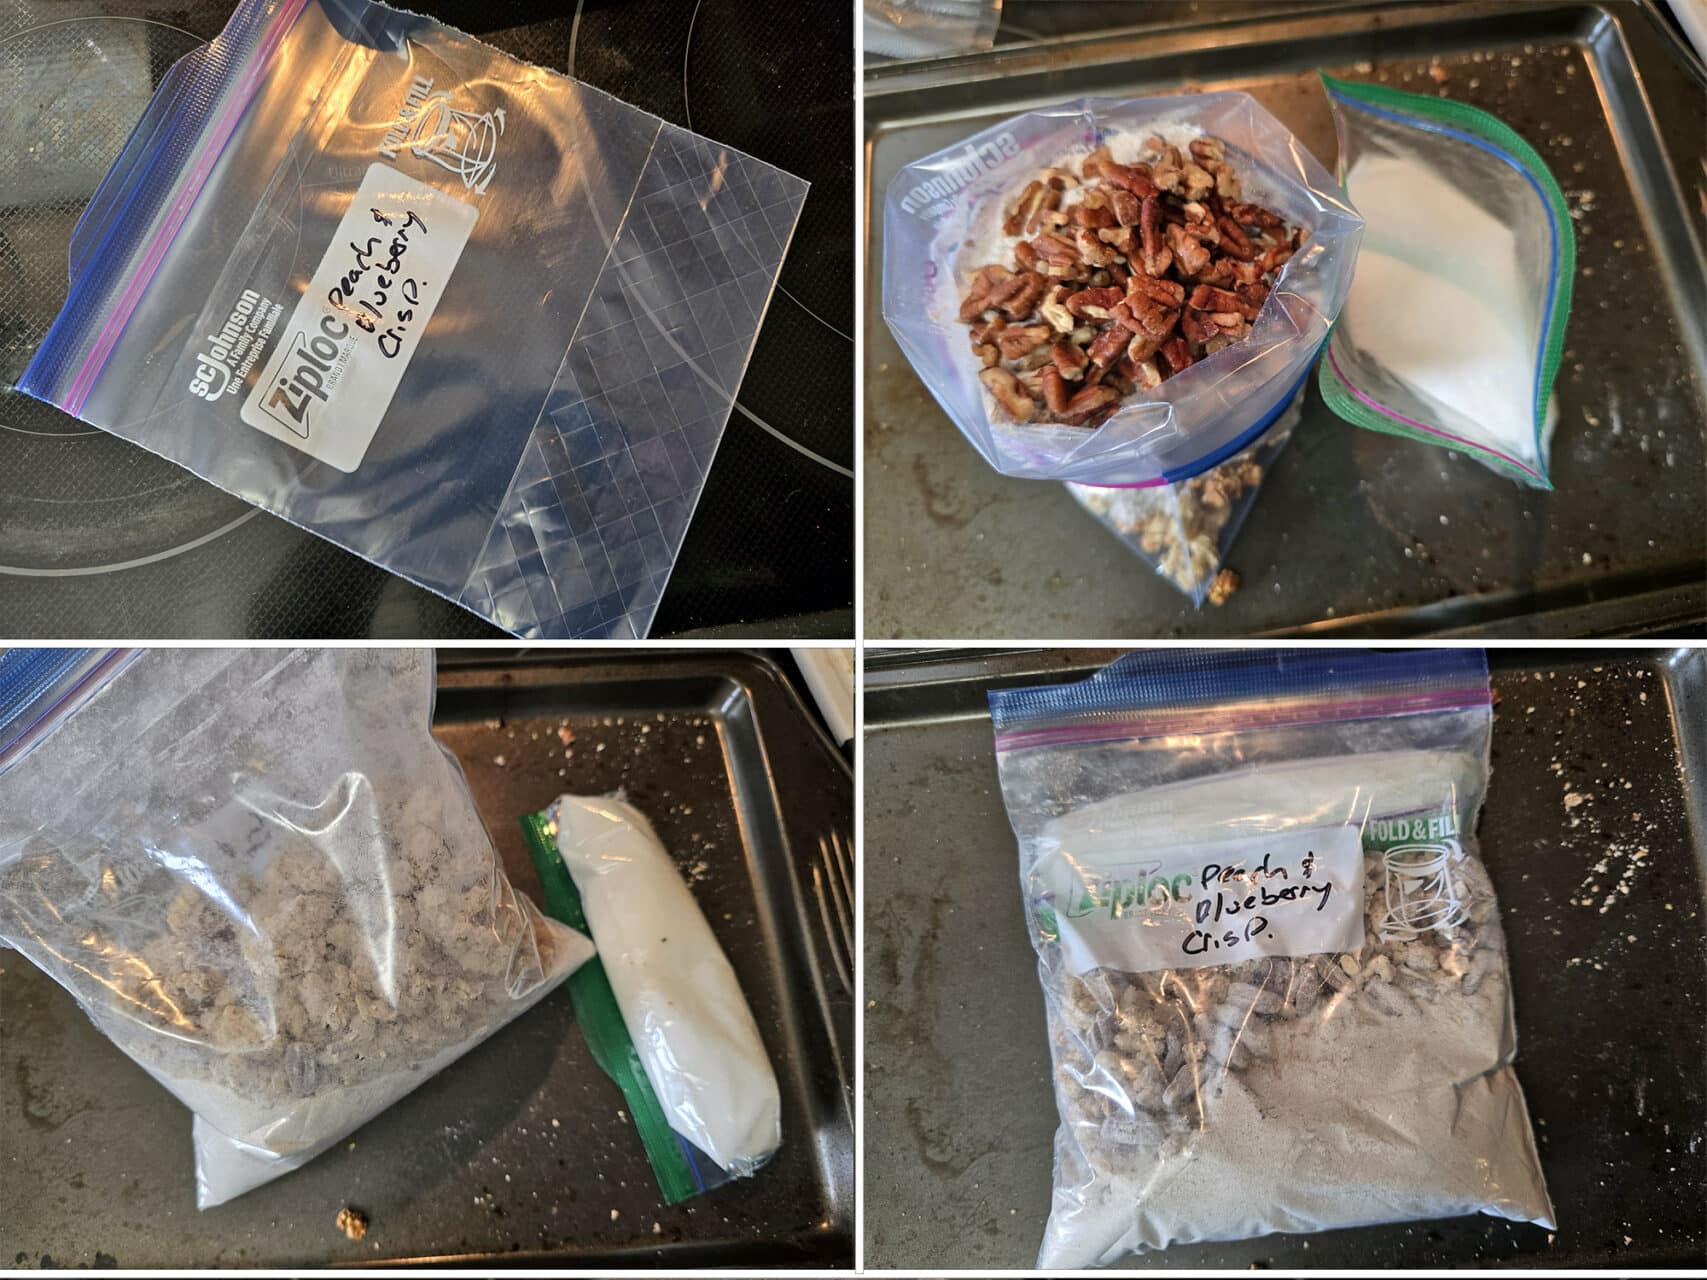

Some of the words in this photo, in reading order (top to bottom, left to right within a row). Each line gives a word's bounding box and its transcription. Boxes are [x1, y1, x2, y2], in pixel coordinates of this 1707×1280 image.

[246, 297, 273, 334] Company
[226, 375, 244, 395] Une
[237, 337, 267, 378] Entreprise
[259, 303, 284, 339] Familiale
[231, 335, 252, 361] Family
[226, 356, 238, 368] A
[1368, 819, 1410, 842] FOLD
[1411, 819, 1427, 841] &
